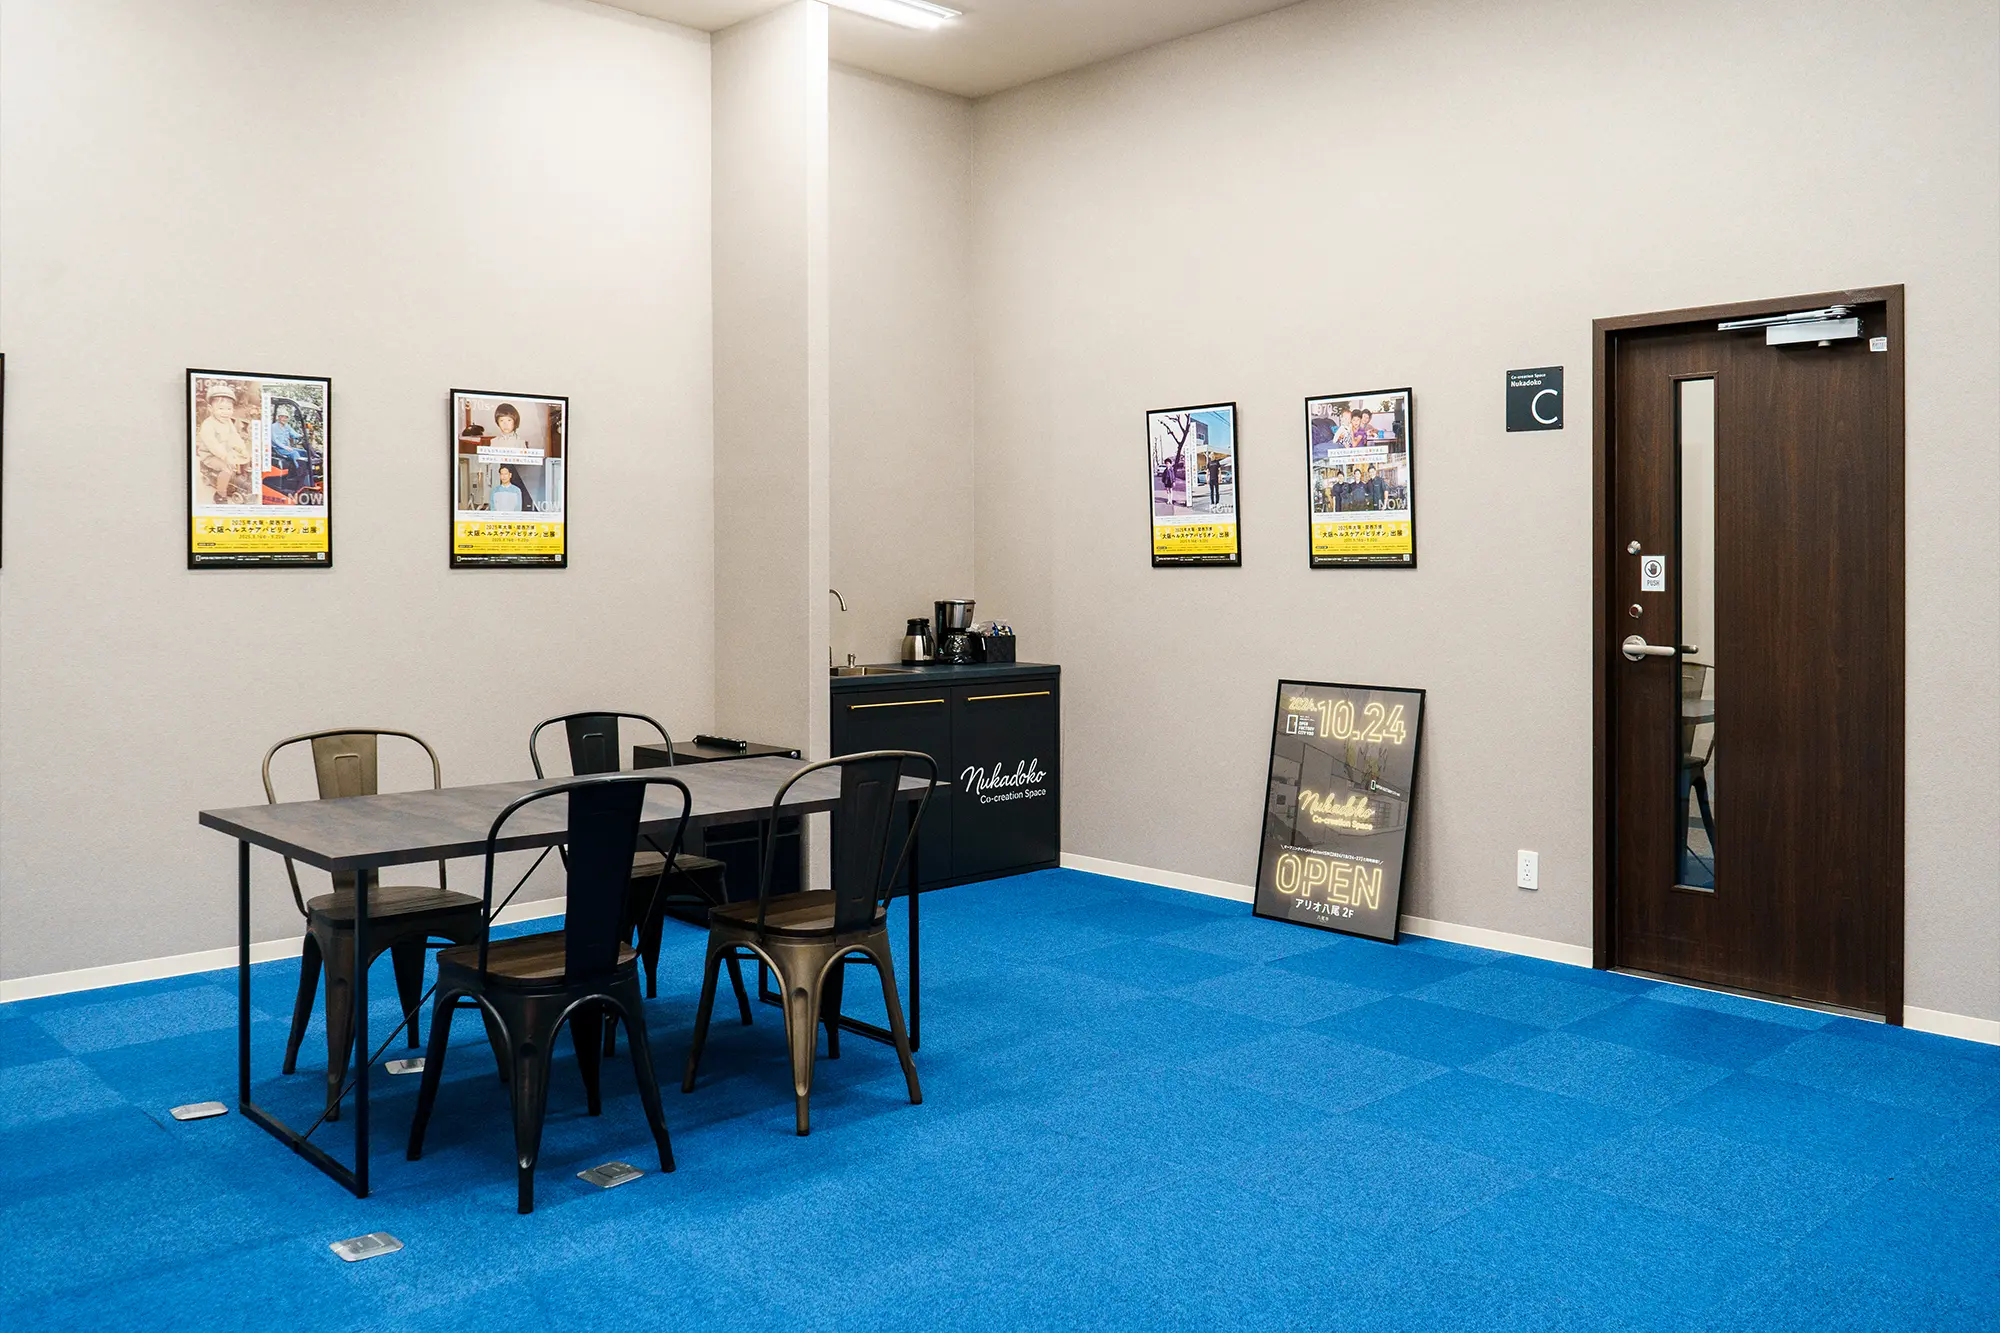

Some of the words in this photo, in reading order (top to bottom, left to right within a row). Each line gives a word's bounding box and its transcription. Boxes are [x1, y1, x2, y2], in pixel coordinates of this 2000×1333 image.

[1511, 379, 1542, 387] Nukadoko
[1531, 388, 1558, 424] C
[1318, 700, 1406, 744] 10.24
[961, 758, 1046, 795] Nukadoko
[980, 791, 1023, 804] Co-creation
[1024, 788, 1046, 799] Space
[1298, 789, 1375, 818] Nukadoko
[1312, 815, 1351, 828] Co-creation
[1352, 820, 1373, 830] Space
[1276, 853, 1382, 910] OPEN
[1295, 898, 1340, 917] アリオ八尾
[1342, 906, 1355, 919] 2F
